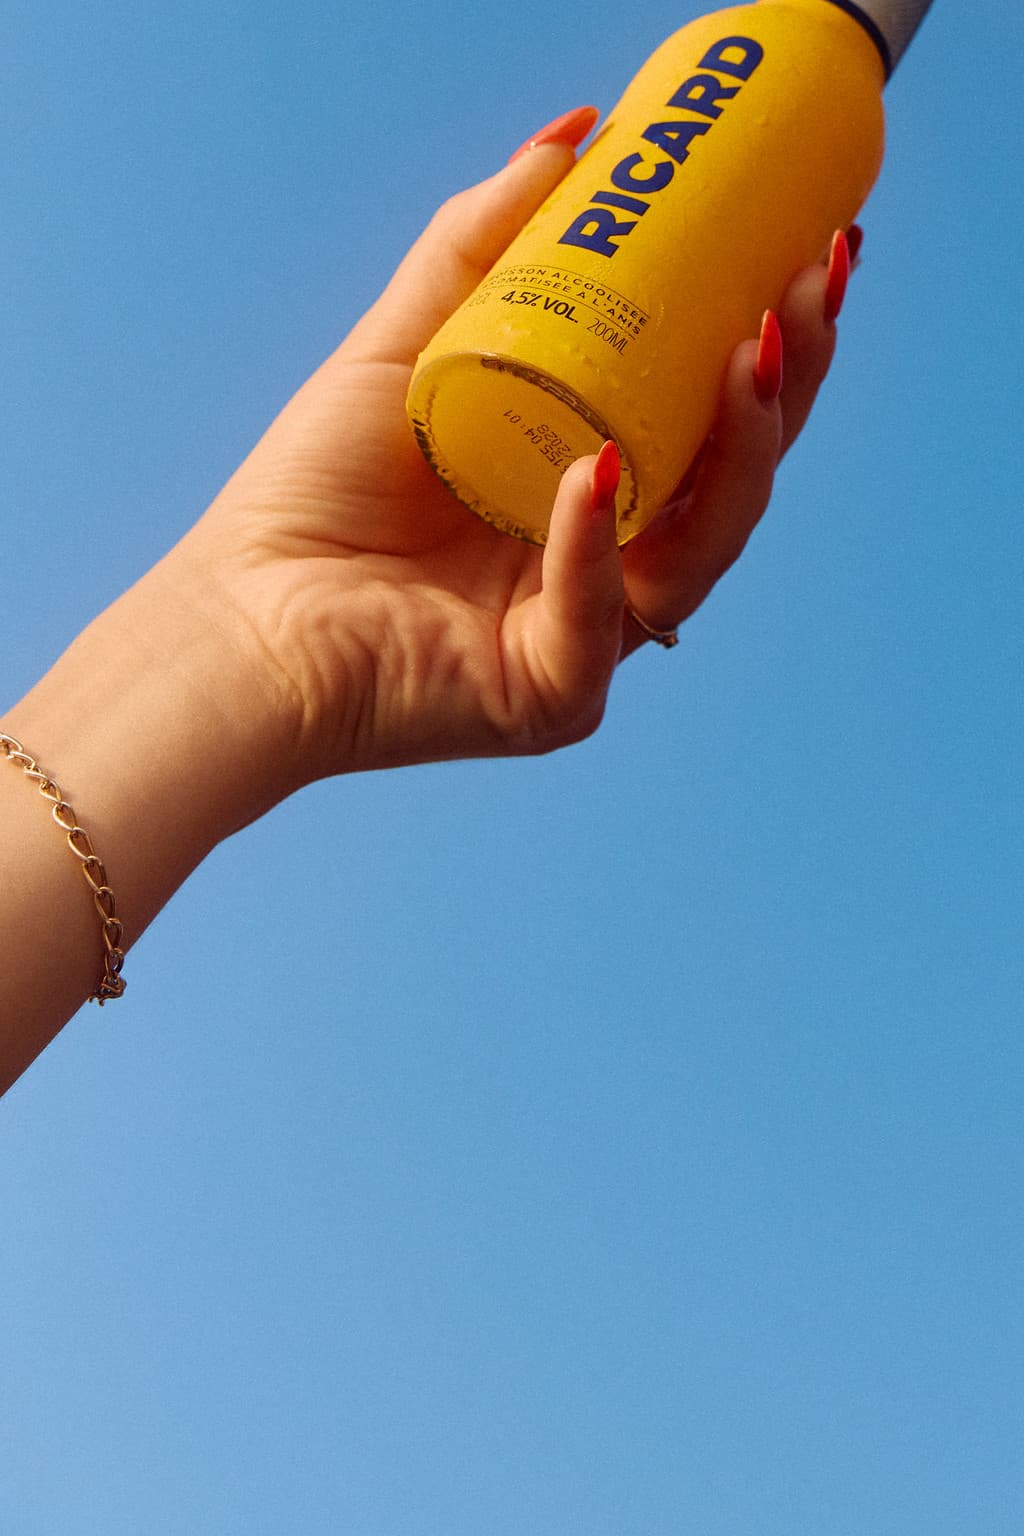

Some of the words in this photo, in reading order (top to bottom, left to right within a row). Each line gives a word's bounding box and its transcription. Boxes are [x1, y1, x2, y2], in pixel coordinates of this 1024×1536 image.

[556, 35, 764, 258] RICARD
[501, 290, 543, 307] 4,5%
[543, 296, 579, 324] VOL.
[592, 298, 642, 336] L'ANIS
[586, 317, 630, 356] 200ML
